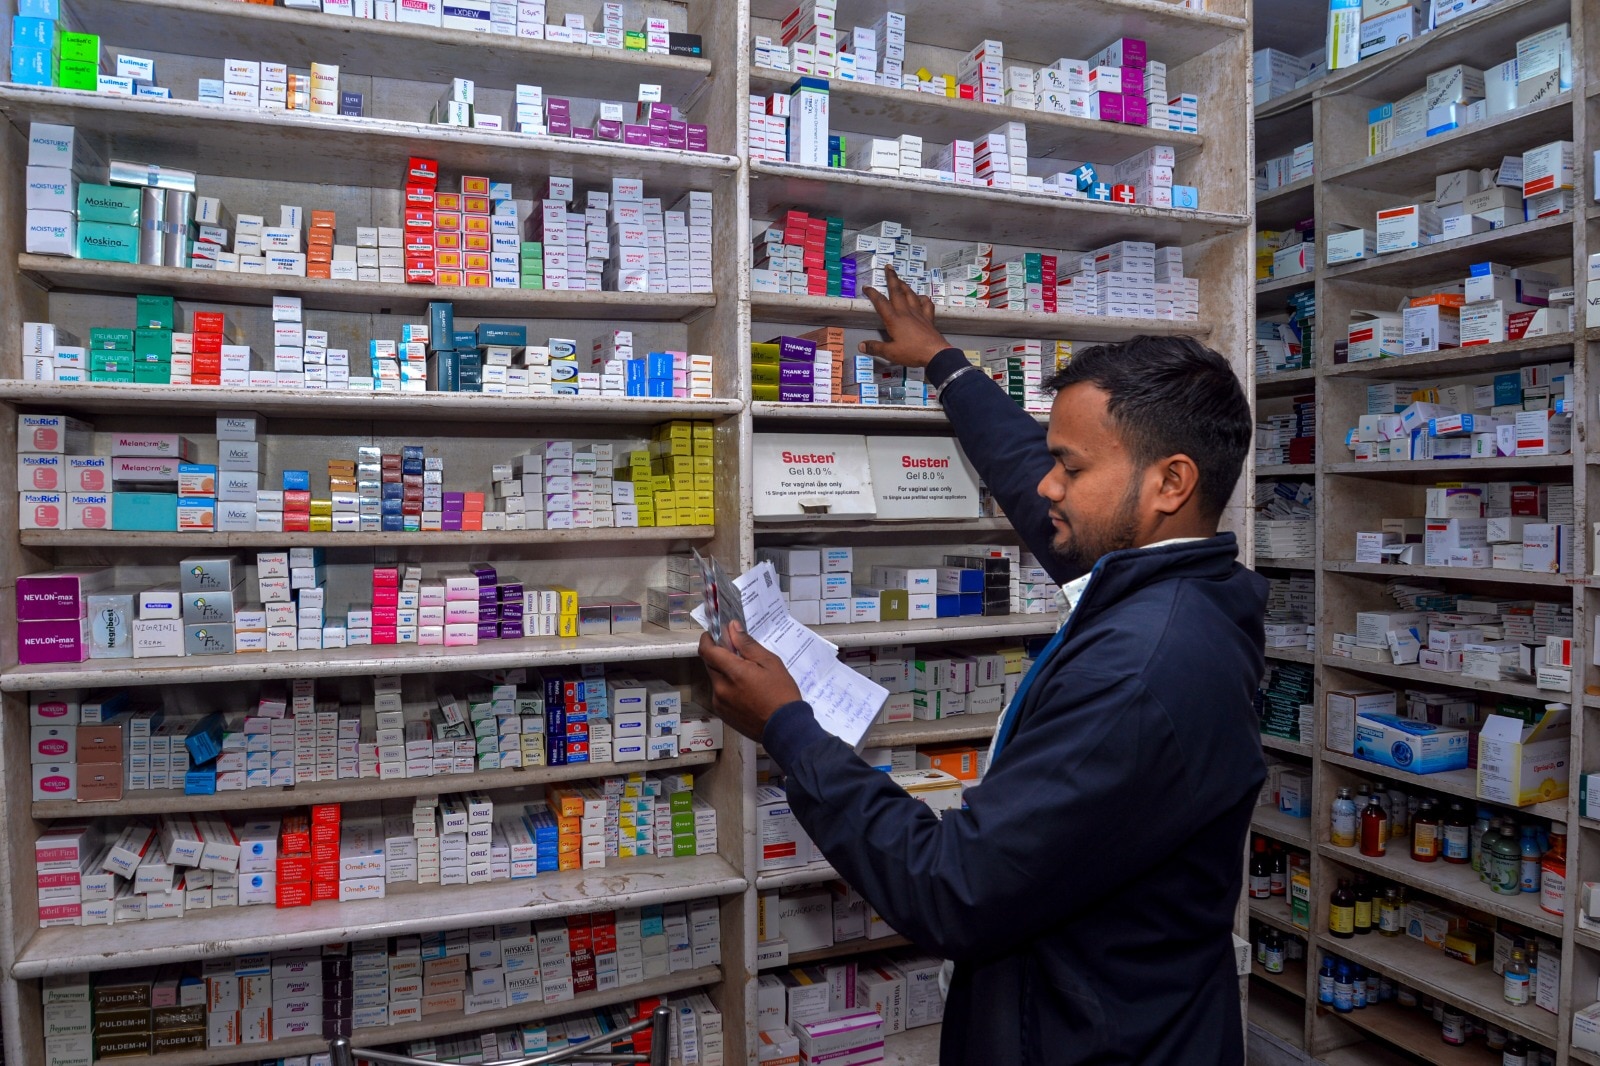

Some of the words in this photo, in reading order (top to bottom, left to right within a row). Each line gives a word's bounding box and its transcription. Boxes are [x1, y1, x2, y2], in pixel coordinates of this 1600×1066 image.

[119, 58, 149, 68] Lulimac
[99, 78, 129, 87] Lulimac
[33, 138, 71, 148] MOISTUREX
[84, 197, 124, 208] Moskina
[30, 225, 68, 234] MOISTUREX
[84, 236, 123, 247] Moskina
[58, 352, 79, 360] MSONE
[23, 418, 58, 426] MaxRich
[227, 419, 246, 428] Moiz
[37, 431, 44, 441] E
[229, 449, 249, 458] Moiz
[782, 451, 835, 465] Susten
[23, 457, 58, 465] MaxRich
[71, 458, 105, 467] MaxRich
[901, 455, 950, 469] Susten
[36, 470, 44, 480] E
[789, 467, 805, 476] Gel
[807, 467, 822, 476] 8.0
[822, 467, 832, 476] %
[906, 472, 921, 480] Gel
[922, 472, 935, 480] 8.0
[936, 472, 945, 480] %
[83, 472, 91, 481] E
[229, 480, 248, 489] Moiz
[792, 481, 816, 489] vaginal
[828, 481, 842, 489] only
[25, 495, 60, 503] MaxRich
[72, 495, 106, 504] MaxRich
[37, 508, 45, 518] E
[85, 509, 92, 519] E
[228, 510, 247, 519] Moiz
[24, 592, 74, 602] NEVLON-max
[107, 608, 115, 649] Negribest
[24, 635, 75, 645] NEVLON-max
[472, 809, 490, 817] OSIL
[447, 818, 465, 827] OSIL
[471, 829, 488, 837] OSIL
[59, 849, 76, 857] First
[470, 850, 488, 858] OSIL
[471, 870, 488, 878] OSIL
[61, 906, 79, 914] First
[540, 936, 563, 944] PHYSIOGEL
[505, 945, 535, 955] PHYSIOGEL
[392, 962, 416, 970] PIGMENTO
[542, 959, 565, 968] PHYSIOGEL
[509, 978, 540, 988] PHYSIOGEL
[544, 983, 567, 991] PHYSIOGEL
[394, 985, 418, 993] PIGMENTO
[99, 993, 147, 1003] PULDEM-HI
[392, 1008, 417, 1016] PIGMENTO
[99, 1017, 147, 1028] PULDEM-HI
[156, 1037, 186, 1046] PULDEM
[187, 1035, 203, 1043] LITE
[100, 1041, 148, 1052] PULDEM-HI
